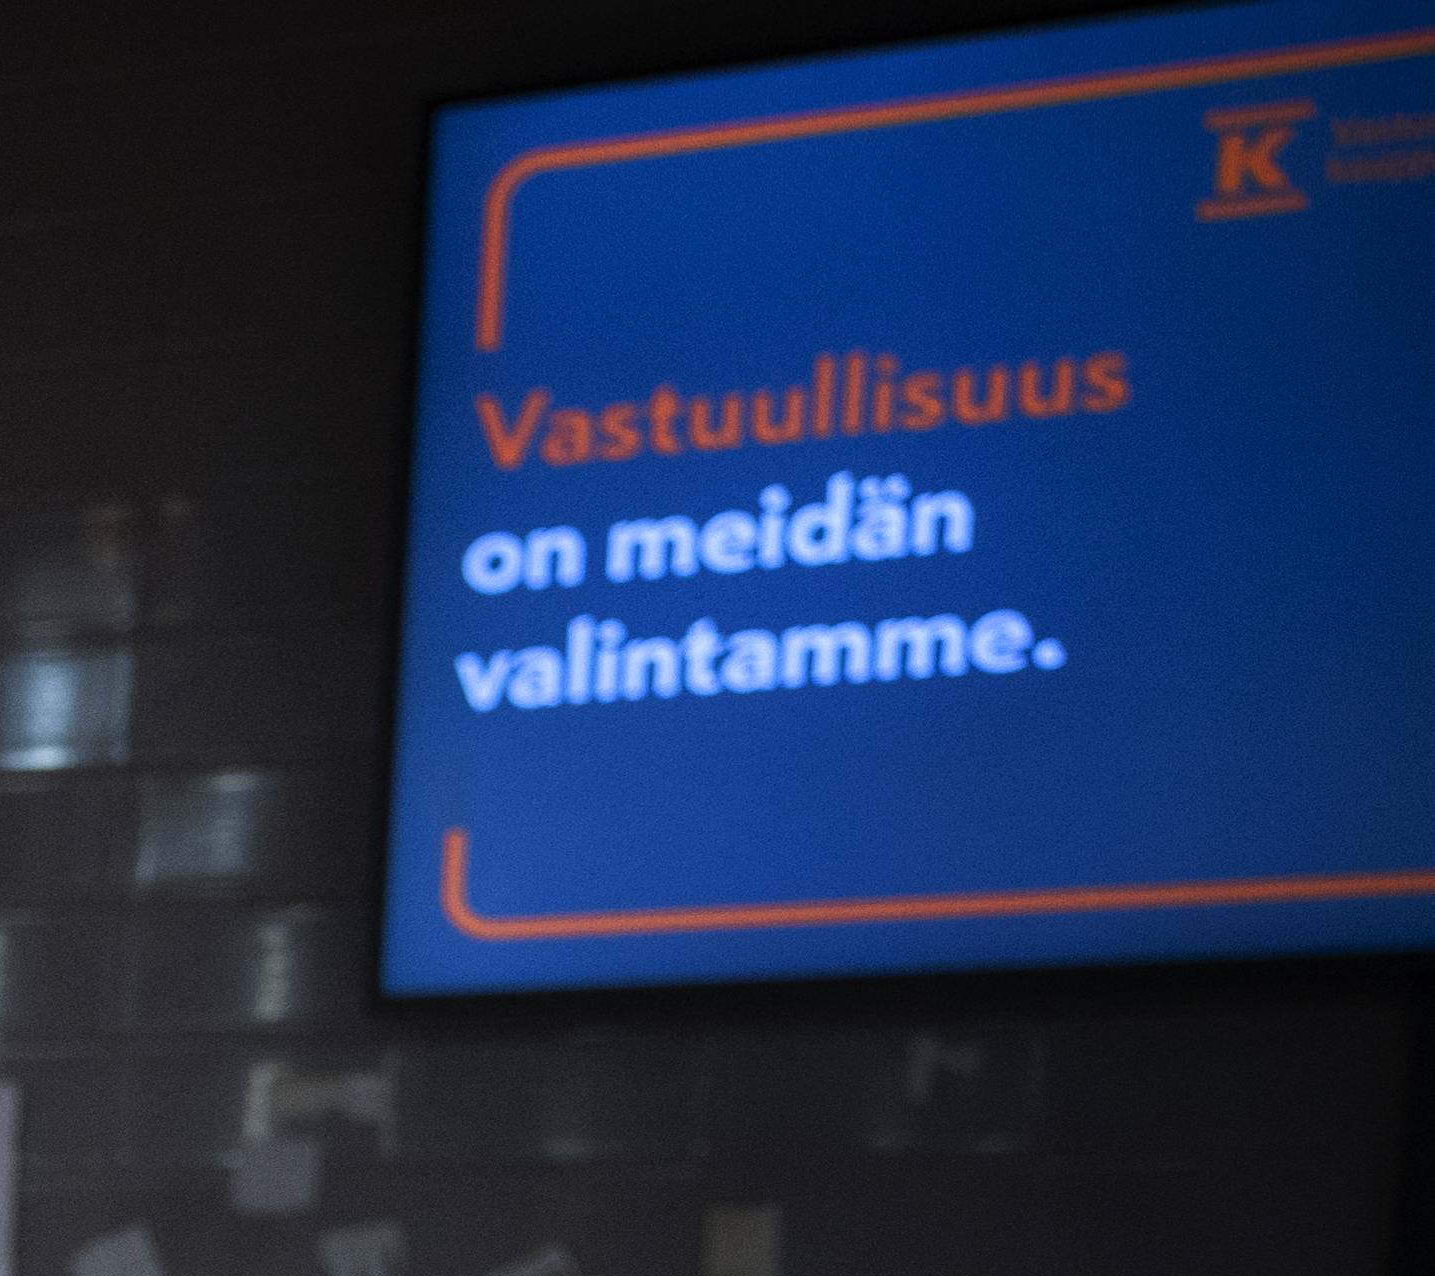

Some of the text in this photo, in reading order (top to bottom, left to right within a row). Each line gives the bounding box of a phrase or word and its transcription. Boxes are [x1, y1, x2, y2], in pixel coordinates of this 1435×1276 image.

[1206, 110, 1306, 208] K
[475, 351, 1131, 469] Vastuullisuus
[461, 470, 975, 596] on meidän
[454, 609, 1068, 713] valintamme.
